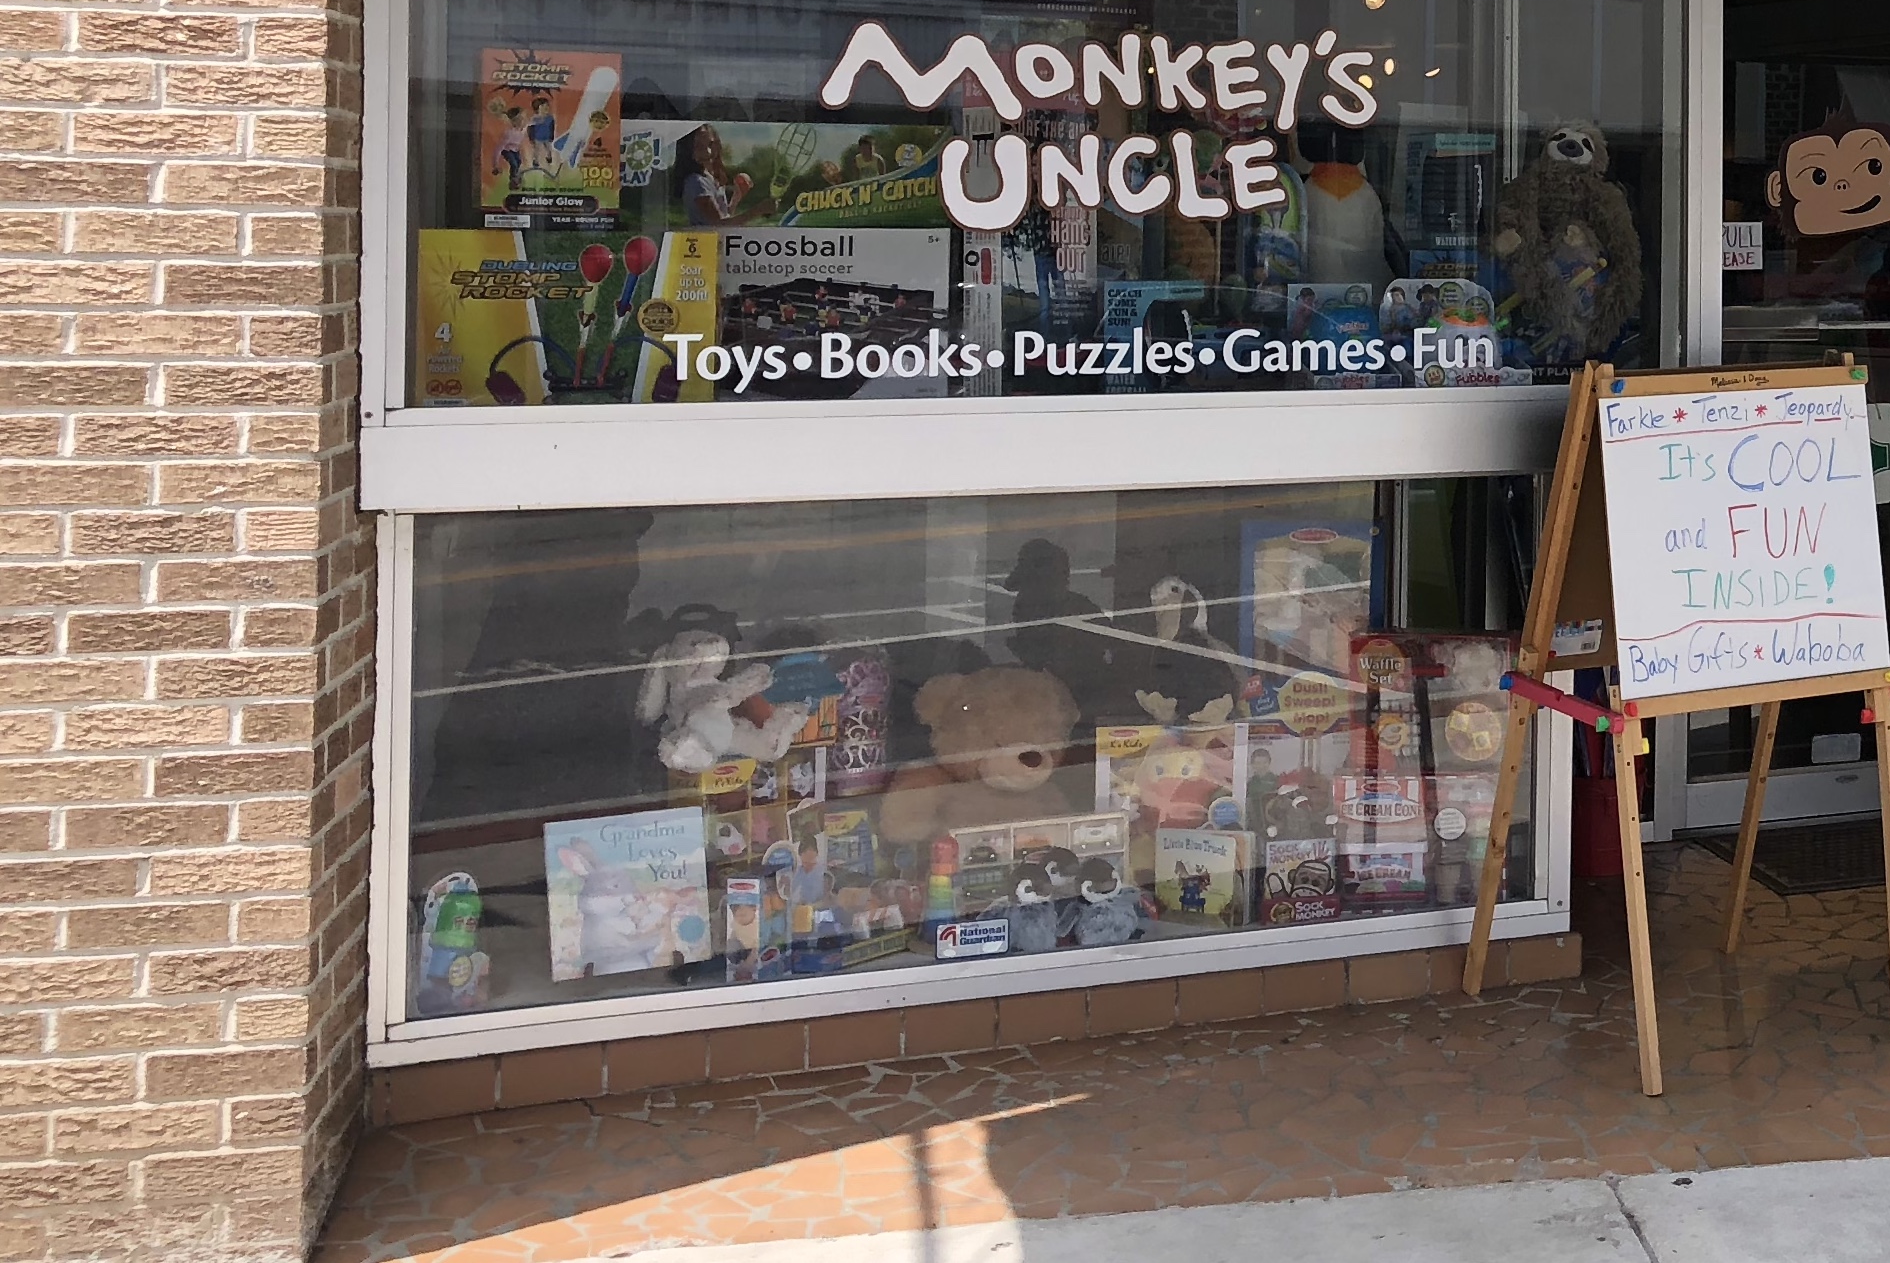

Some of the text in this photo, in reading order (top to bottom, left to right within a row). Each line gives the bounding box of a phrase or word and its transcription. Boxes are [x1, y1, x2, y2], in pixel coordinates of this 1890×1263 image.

[501, 62, 571, 73] STOMP
[491, 70, 573, 82] ROCKET
[820, 20, 1380, 135] MONKEY'S
[581, 166, 614, 181] 100
[940, 129, 1289, 232] UNCLE
[518, 196, 585, 207] Junior Glow
[795, 187, 853, 214] CHUCK
[688, 243, 698, 255] 6
[724, 234, 856, 258] Foosball
[480, 260, 578, 272] DUELING
[1723, 251, 1756, 267] EASE
[725, 259, 855, 278] tabletop soccer
[450, 271, 562, 286] STOMP
[460, 286, 595, 300] ROCKET
[435, 322, 453, 343] 4
[662, 326, 1495, 395] Toys Books Puzzles Games Fun
[1455, 371, 1500, 386] Fubbles
[1606, 403, 1671, 437] Farkle
[1691, 395, 1750, 425] Tenzi
[1727, 433, 1862, 493] COOL
[1664, 502, 1828, 559] and FUN
[1628, 622, 1867, 684] Baby Gifts Waboba
[1359, 656, 1402, 672] Waffle
[1368, 671, 1394, 685] Set
[1283, 694, 1336, 708] Sweep!
[1355, 802, 1394, 818] CREAM
[599, 820, 685, 849] Grandma
[627, 842, 678, 863] Loves
[647, 859, 687, 883] You!
[1294, 900, 1324, 913] SOCK
[1294, 908, 1337, 922] MONKEY
[959, 924, 1006, 937] National
